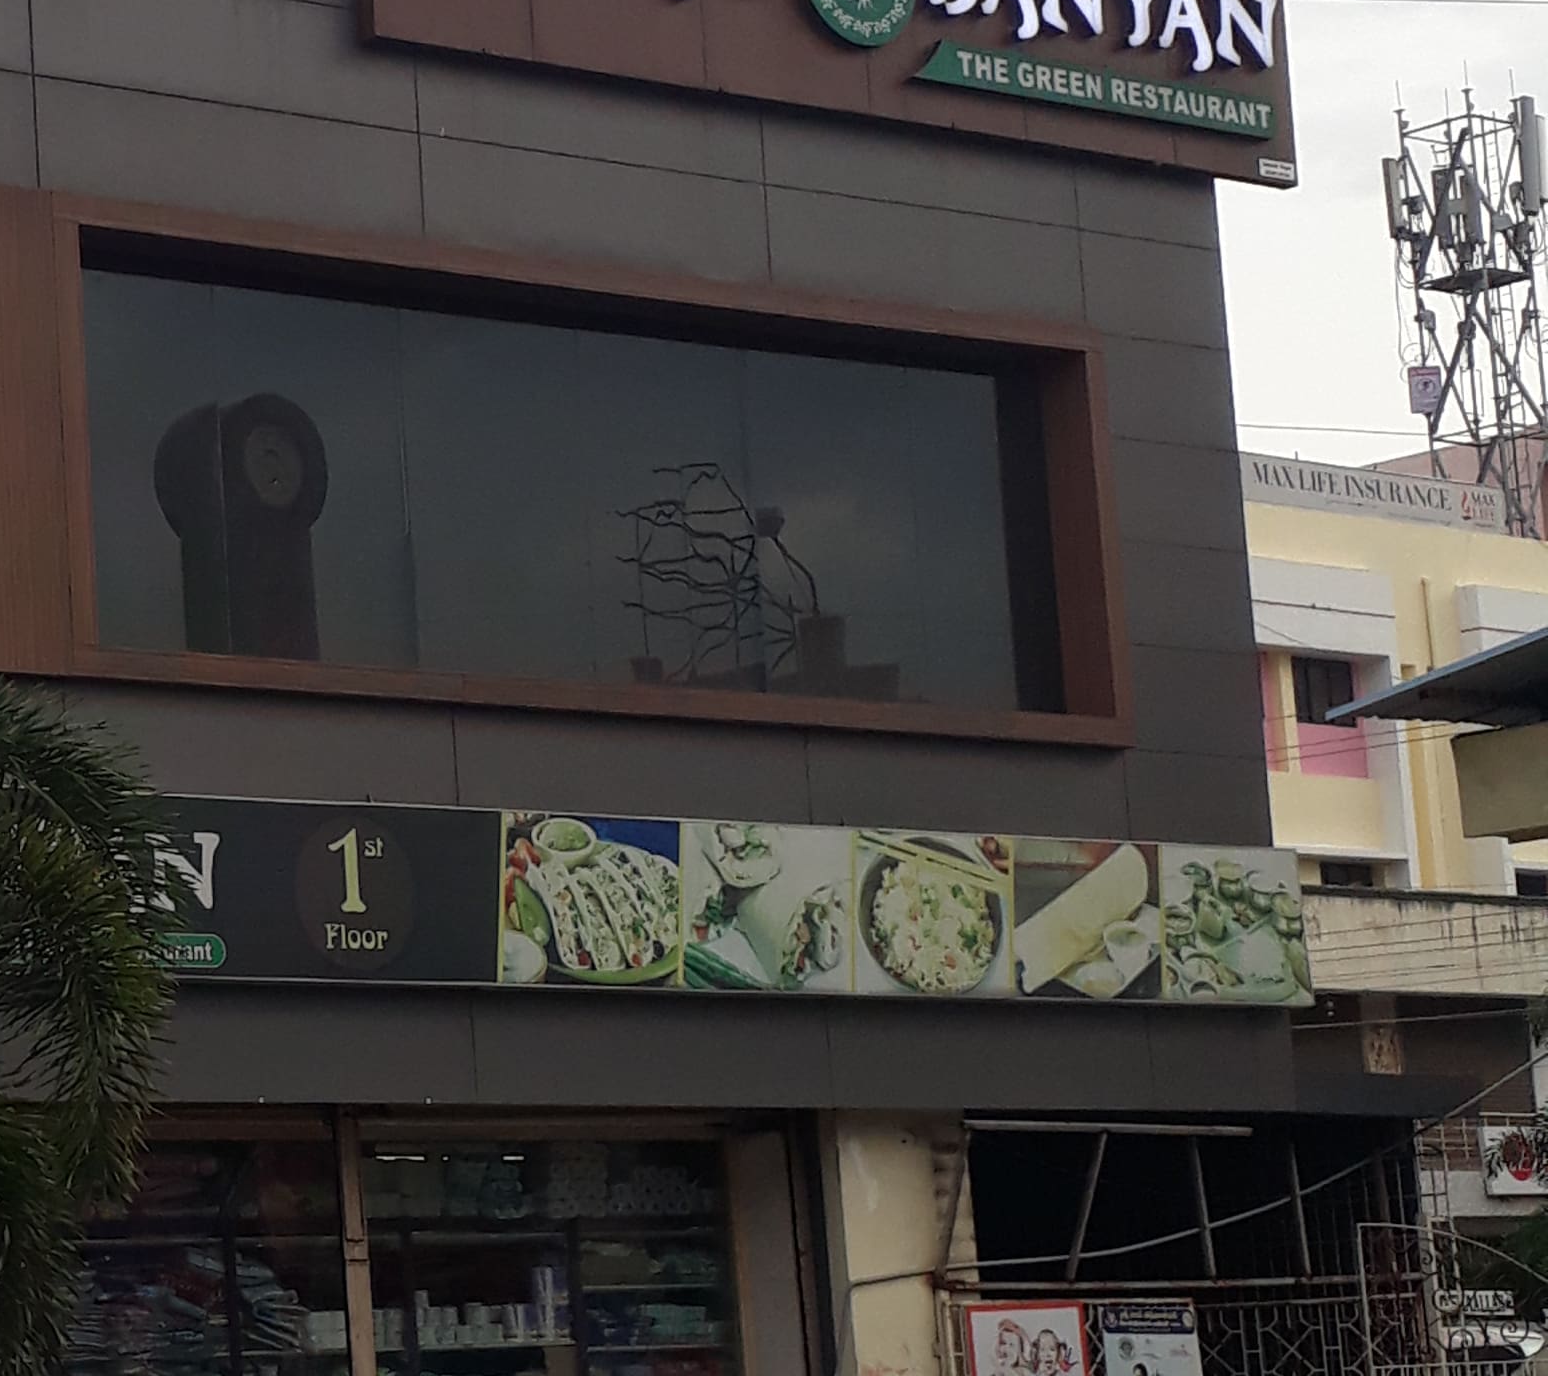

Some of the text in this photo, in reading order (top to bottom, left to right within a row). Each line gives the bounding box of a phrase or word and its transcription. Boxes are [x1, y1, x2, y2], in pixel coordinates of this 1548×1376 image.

[956, 50, 1272, 129] THE GREEN RESTAURANT
[1252, 461, 1453, 512] MAX LIFE INSURANCE
[326, 827, 385, 914] 1st
[323, 922, 389, 951] Floor
